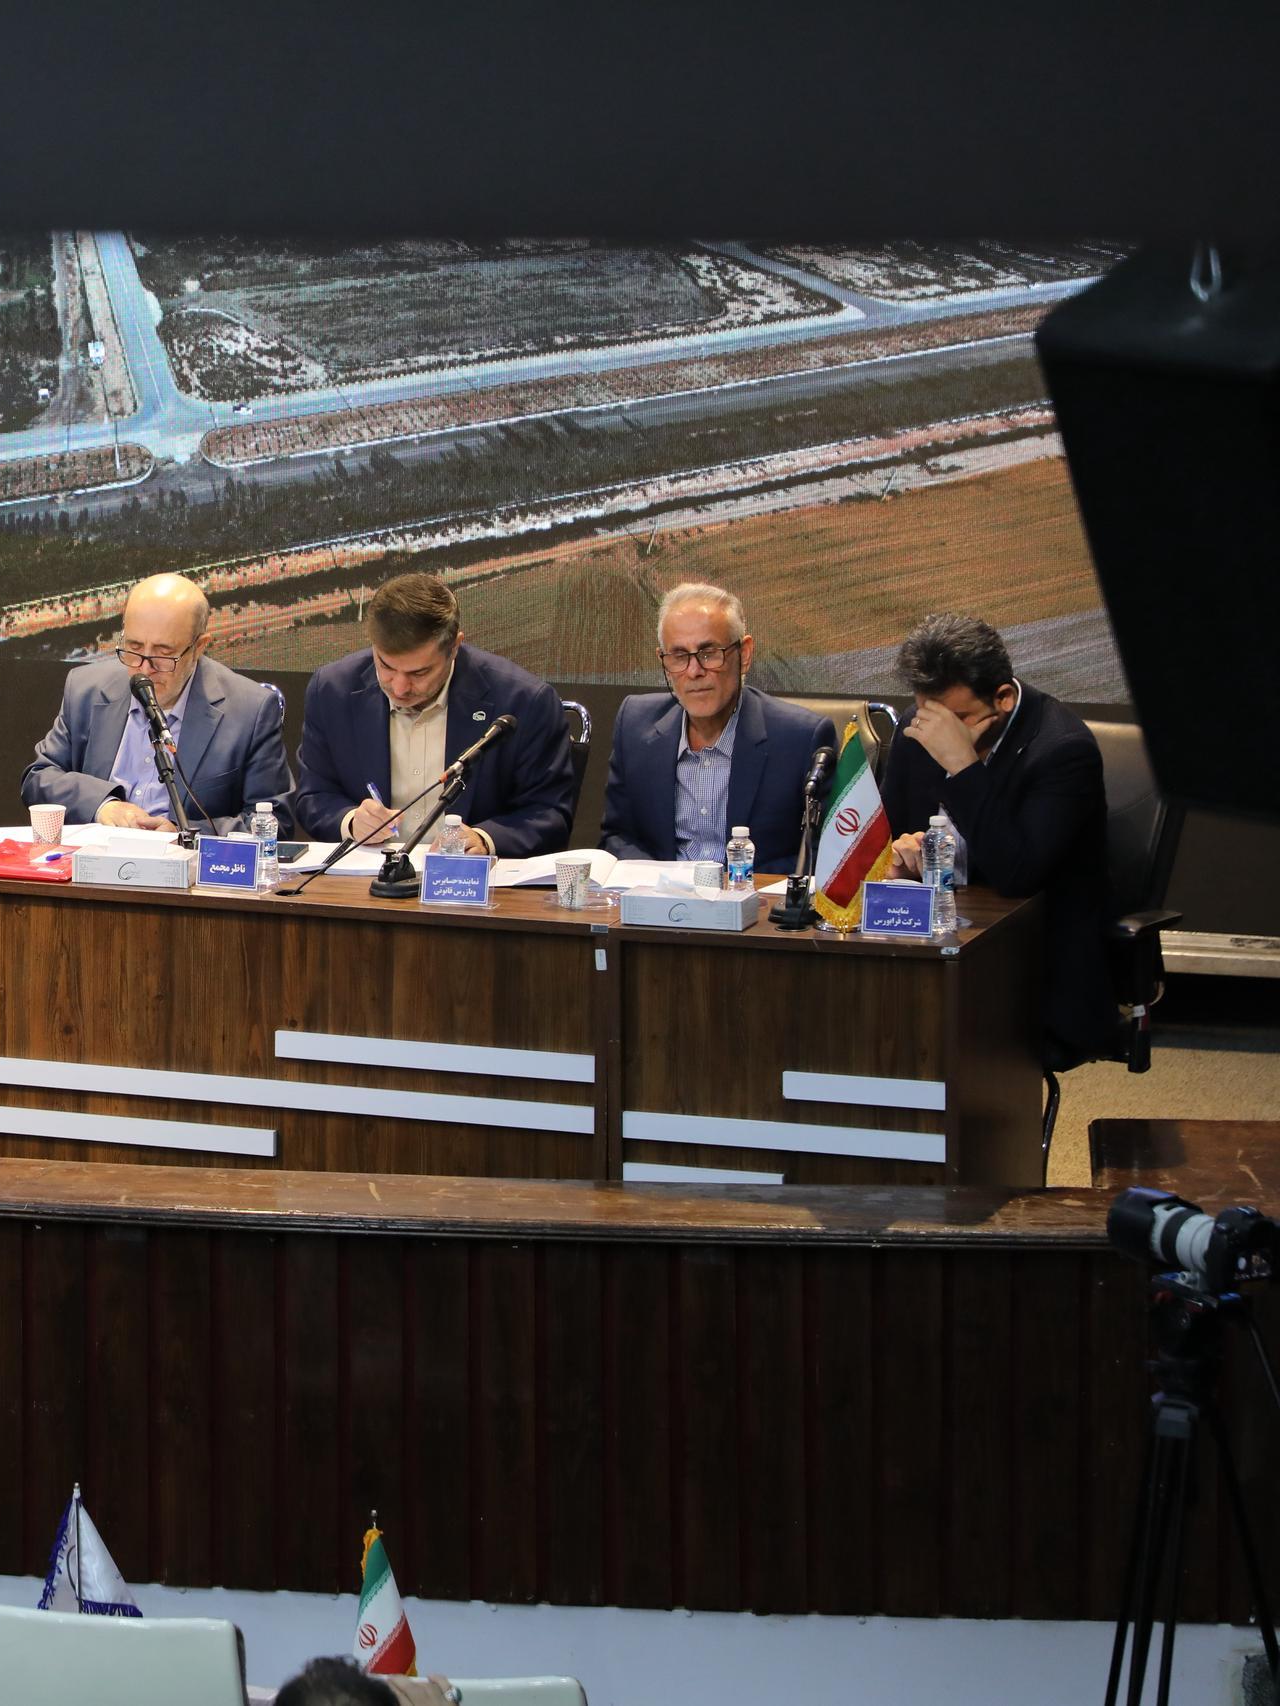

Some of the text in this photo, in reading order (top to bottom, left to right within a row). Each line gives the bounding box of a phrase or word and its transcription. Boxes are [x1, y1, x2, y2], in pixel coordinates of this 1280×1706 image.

[209, 863, 246, 875] ناظر مجمع
[432, 877, 480, 886] نماینده حسابرس
[433, 886, 453, 896] قانونی
[887, 906, 910, 915] نماینده
[873, 917, 922, 928] شرکت فرابورس
